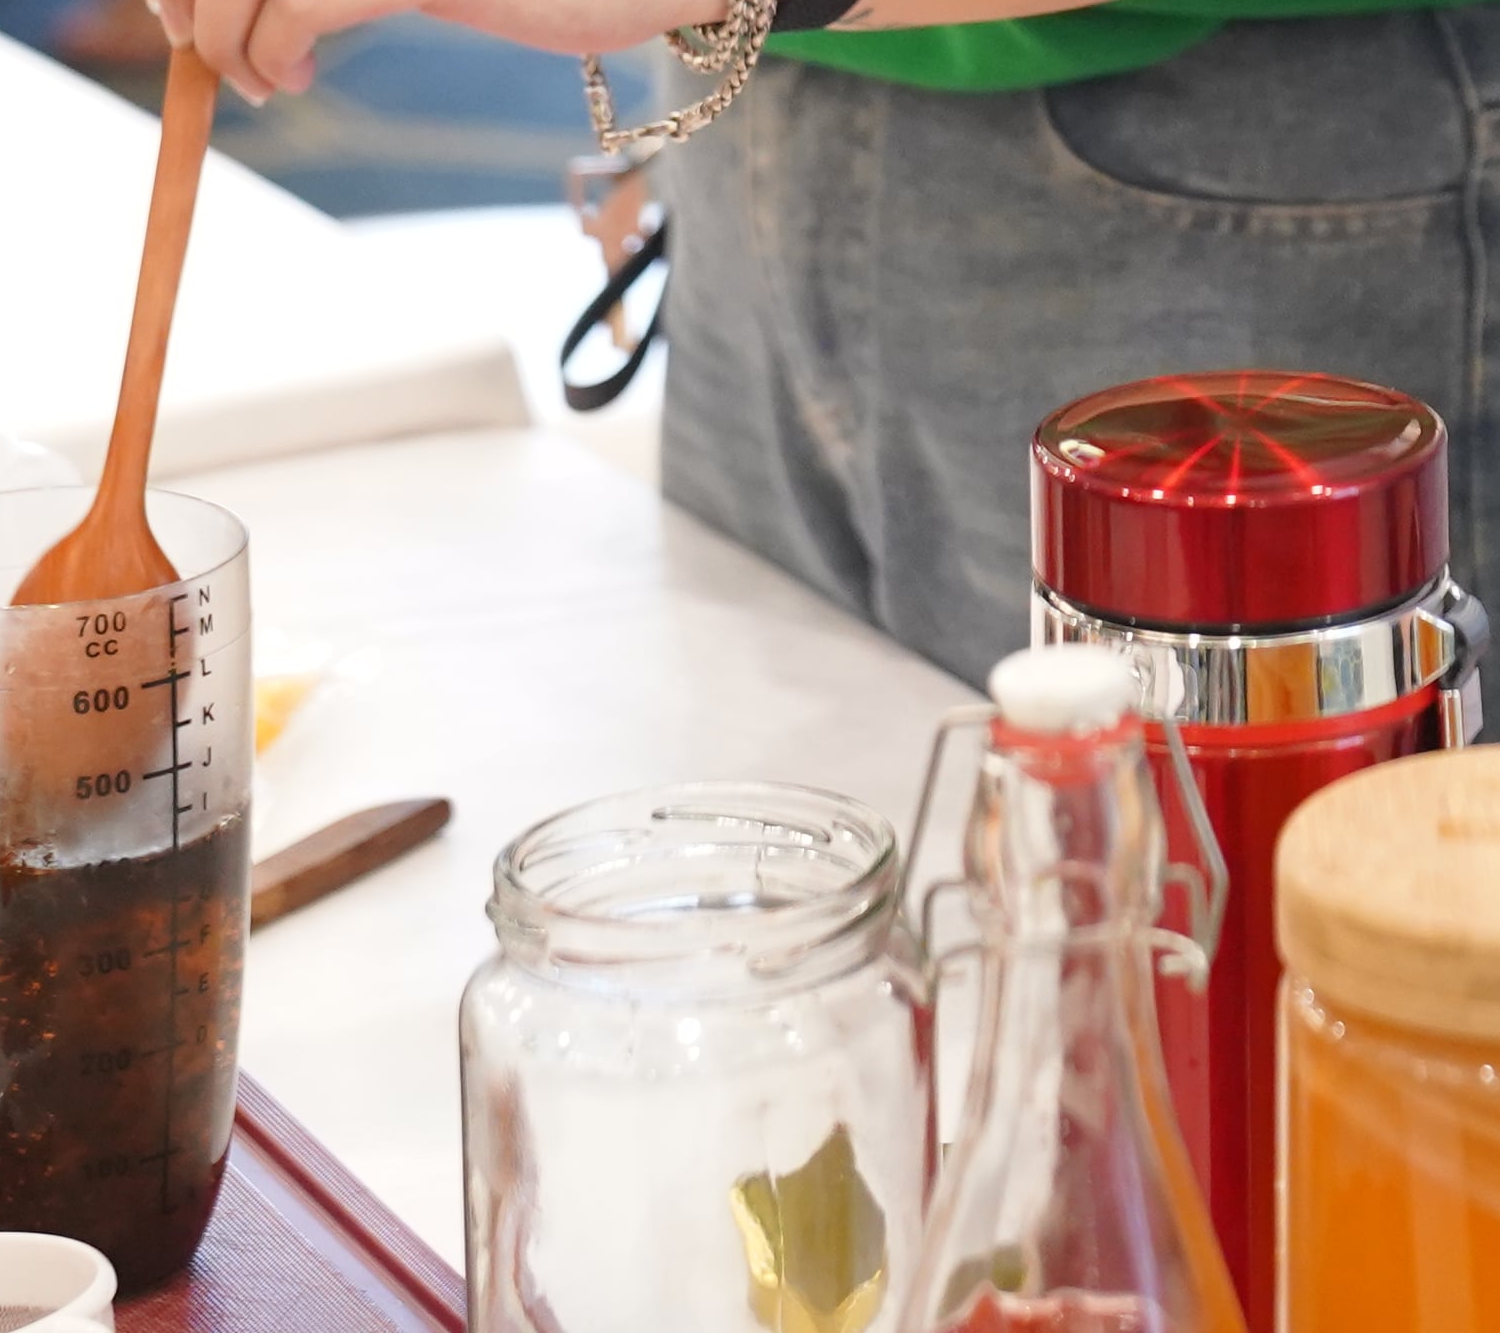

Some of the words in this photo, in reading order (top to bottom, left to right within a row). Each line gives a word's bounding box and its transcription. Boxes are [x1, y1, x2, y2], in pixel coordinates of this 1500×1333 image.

[199, 586, 211, 606] N
[76, 611, 127, 638] 700
[200, 614, 214, 636] M
[202, 659, 212, 676] L
[73, 685, 130, 715] 600
[202, 703, 215, 725] K
[202, 746, 212, 767] J
[76, 769, 131, 799] 500
[78, 947, 131, 976] 300
